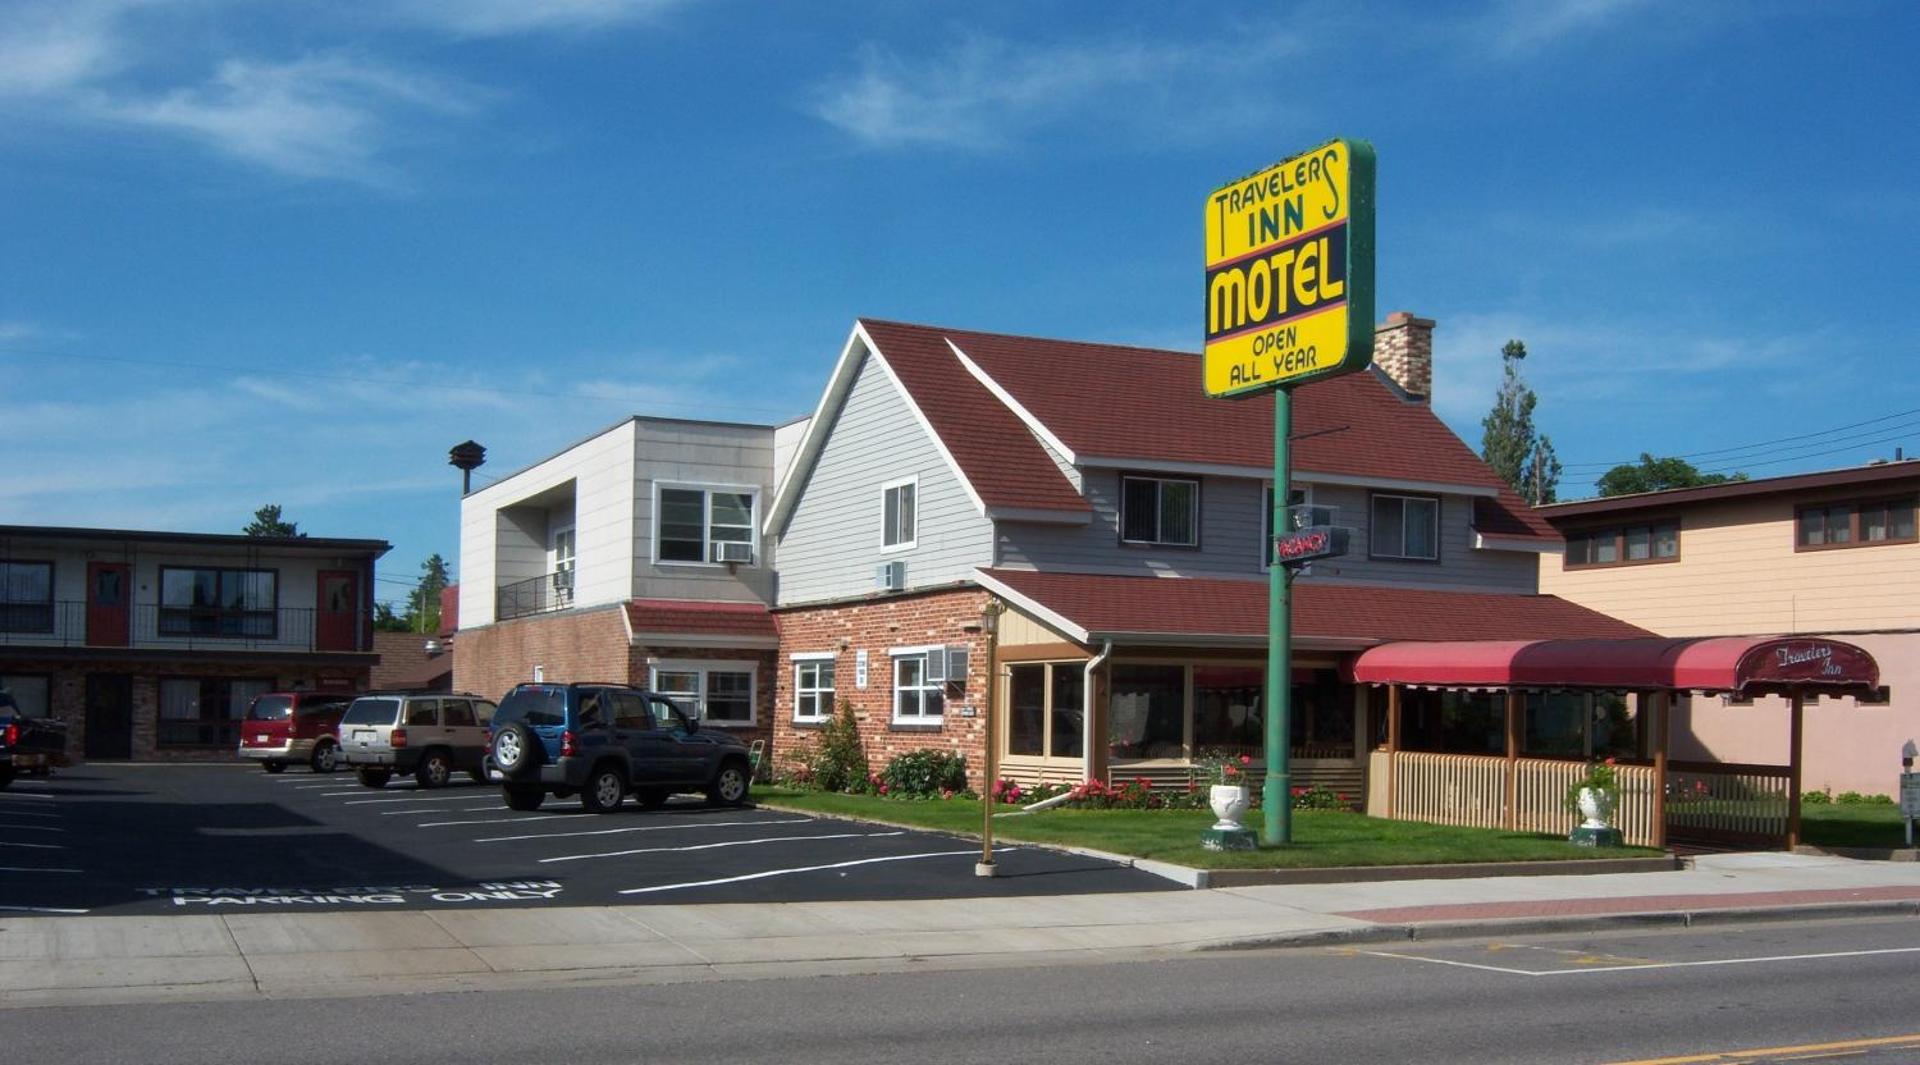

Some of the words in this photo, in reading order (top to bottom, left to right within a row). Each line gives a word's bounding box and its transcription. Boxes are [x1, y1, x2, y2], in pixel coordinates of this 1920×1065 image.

[1216, 150, 1339, 256] TRAVELERS
[1249, 194, 1304, 246] INN
[1210, 237, 1343, 334] MOTEL
[1252, 327, 1297, 356] OPEN
[1231, 362, 1261, 386] ALL
[1274, 349, 1317, 374] YEAR
[1776, 643, 1832, 667] Travelers
[1821, 657, 1842, 675] Inn
[173, 894, 405, 905] PARKING
[432, 888, 563, 902] ONLY
[480, 880, 562, 890] INN
